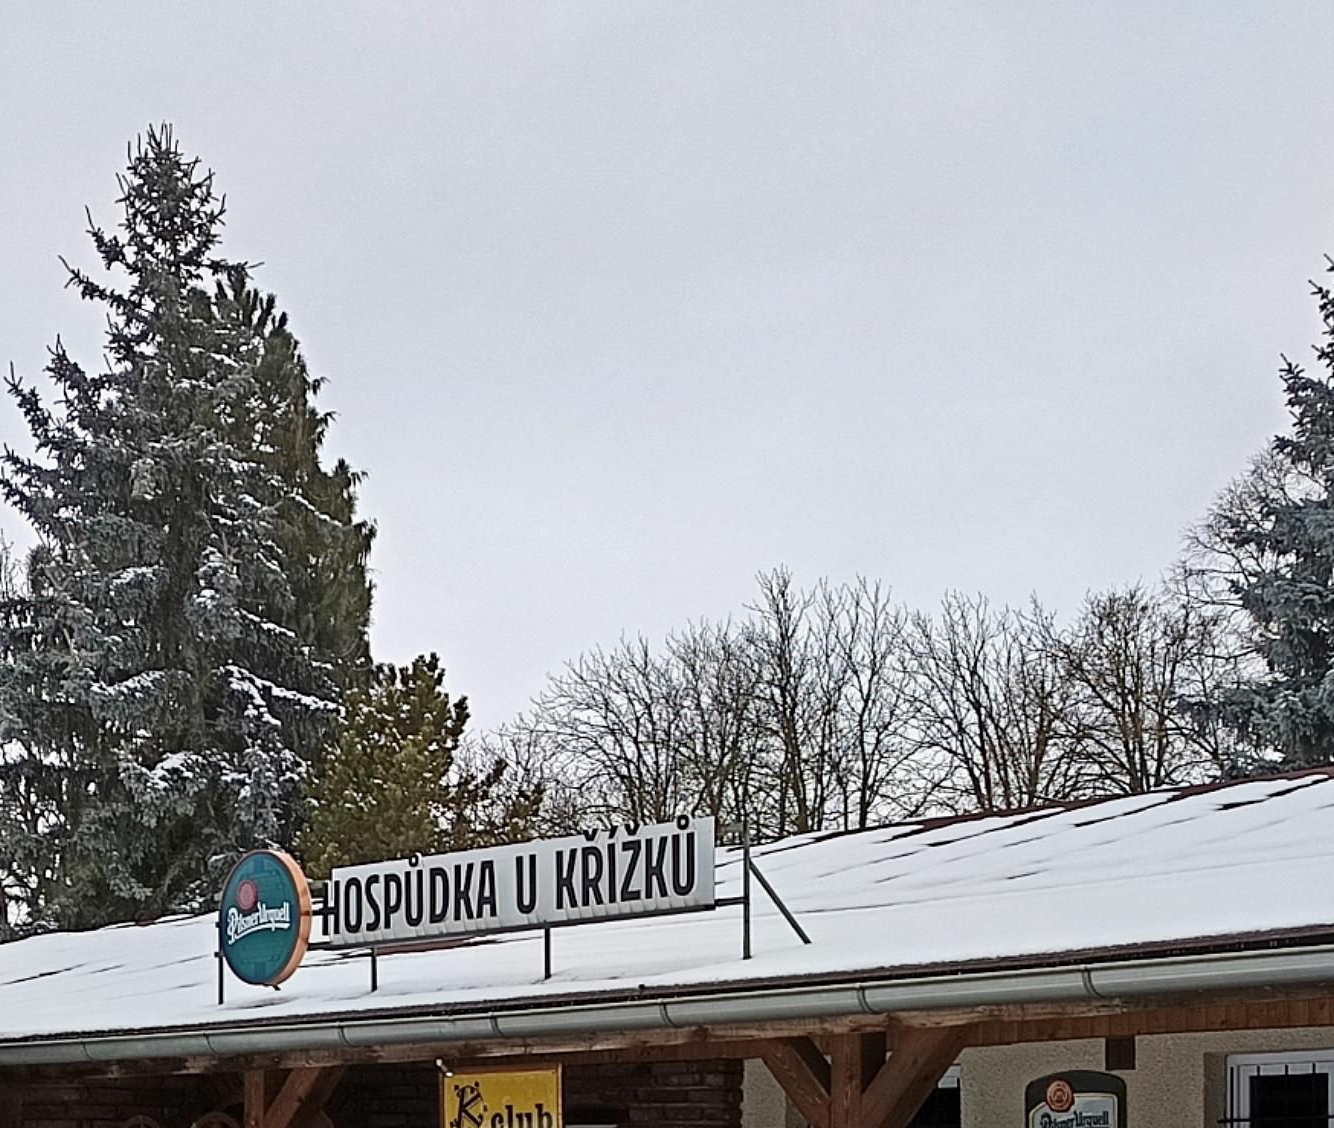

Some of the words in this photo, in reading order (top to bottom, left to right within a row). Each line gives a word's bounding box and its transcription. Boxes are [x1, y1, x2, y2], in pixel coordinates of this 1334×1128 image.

[322, 853, 497, 935] HOSPŮDKA
[516, 855, 536, 914] U
[556, 815, 695, 910] KŘÍŽKŮ
